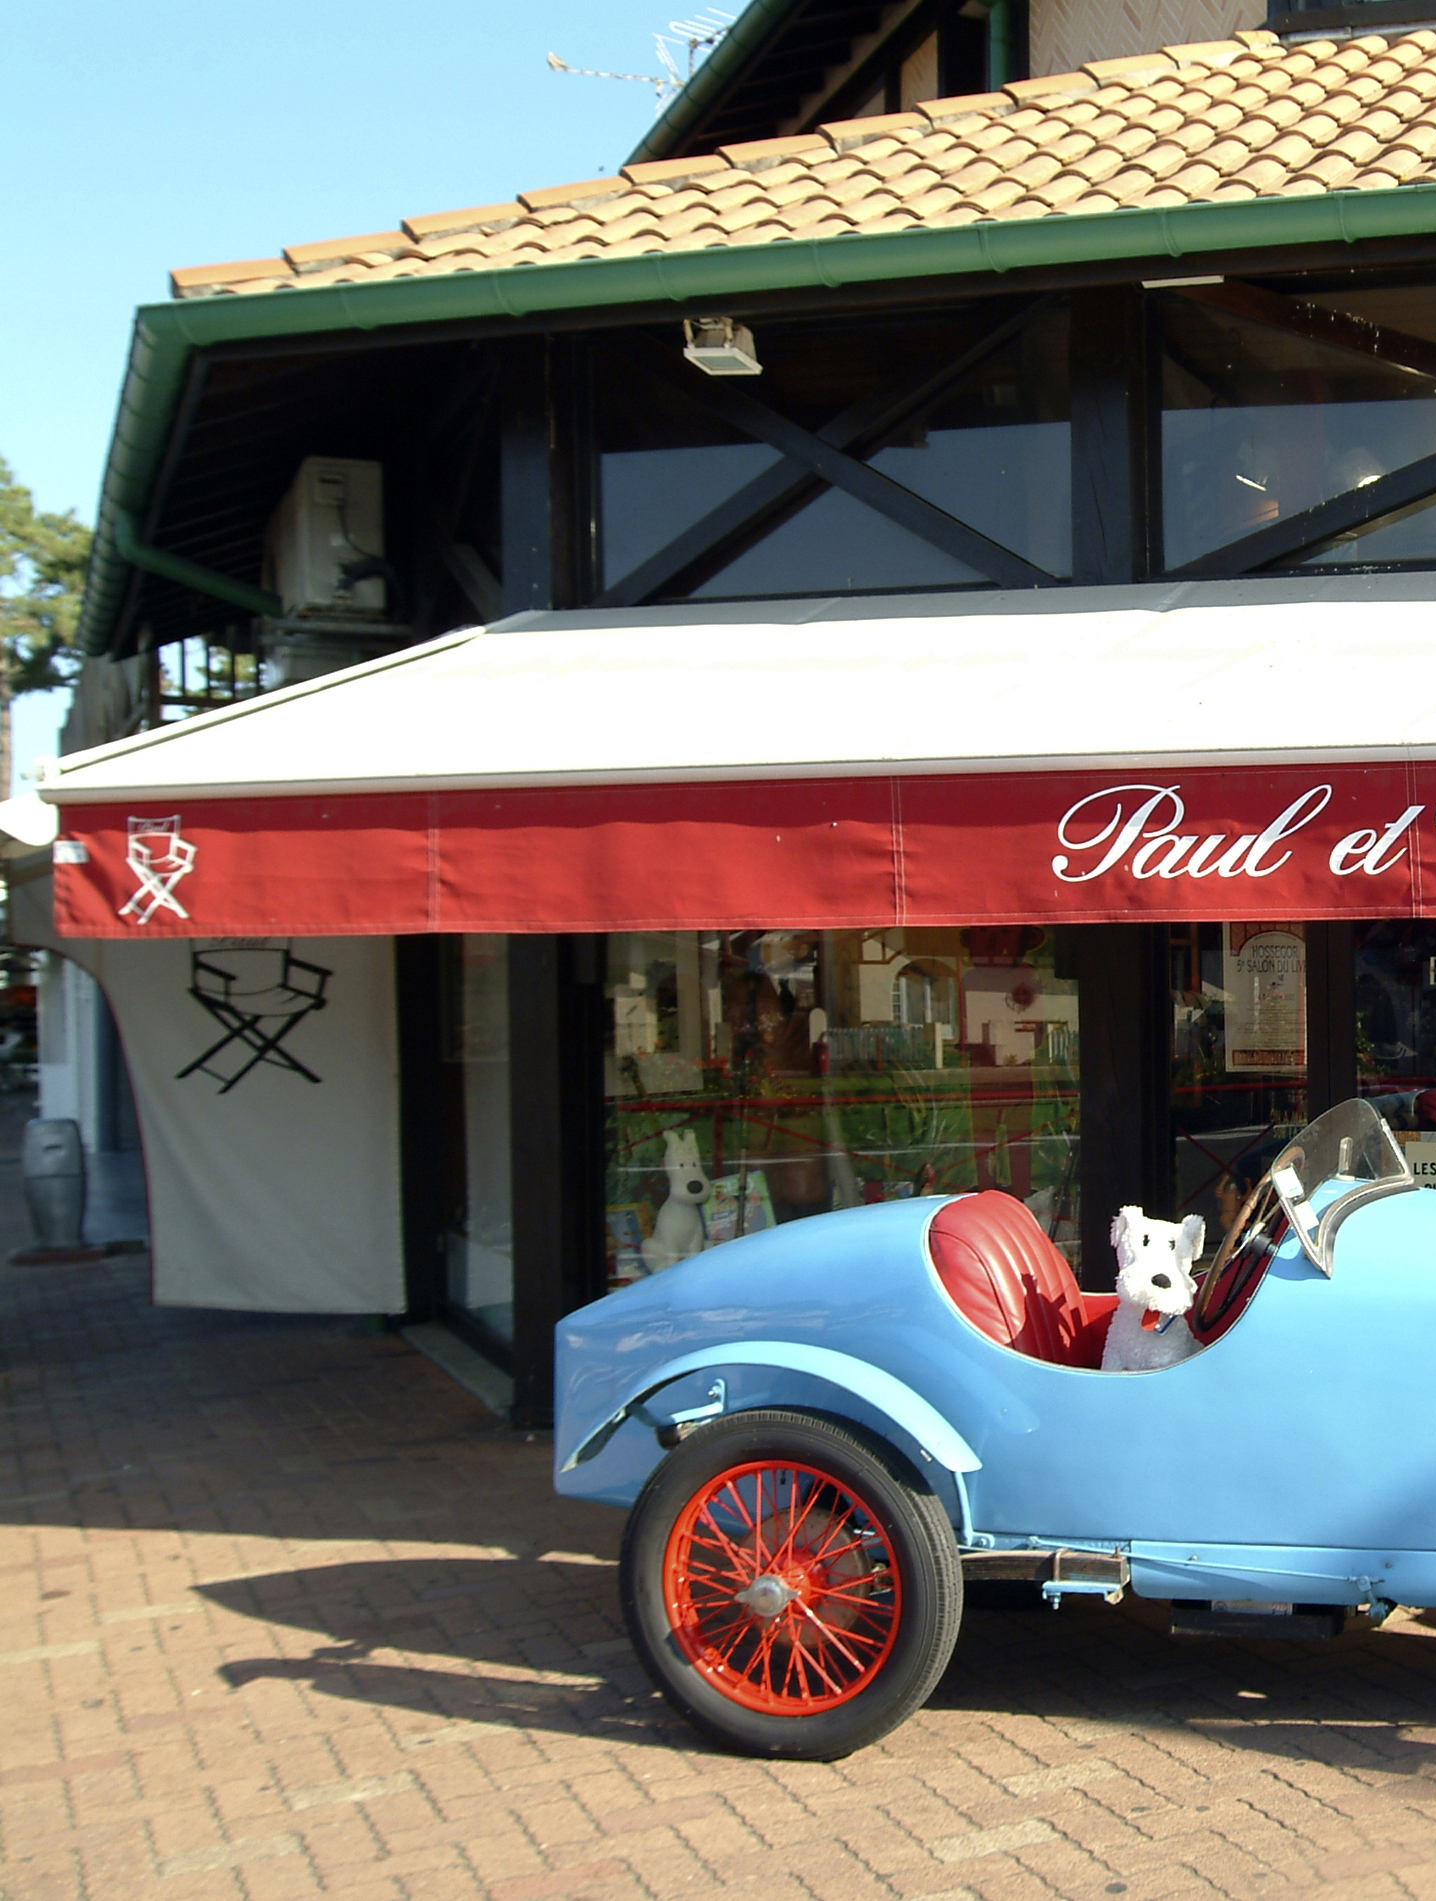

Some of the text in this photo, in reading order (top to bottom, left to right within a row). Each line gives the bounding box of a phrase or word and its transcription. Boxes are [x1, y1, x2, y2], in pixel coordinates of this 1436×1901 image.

[1051, 783, 1332, 882] Paul
[1330, 803, 1424, 877] et
[1252, 944, 1298, 958] HOSSEGOR
[1246, 959, 1275, 972] SALON
[1277, 959, 1288, 972] DU
[1413, 1162, 1436, 1175] LES
